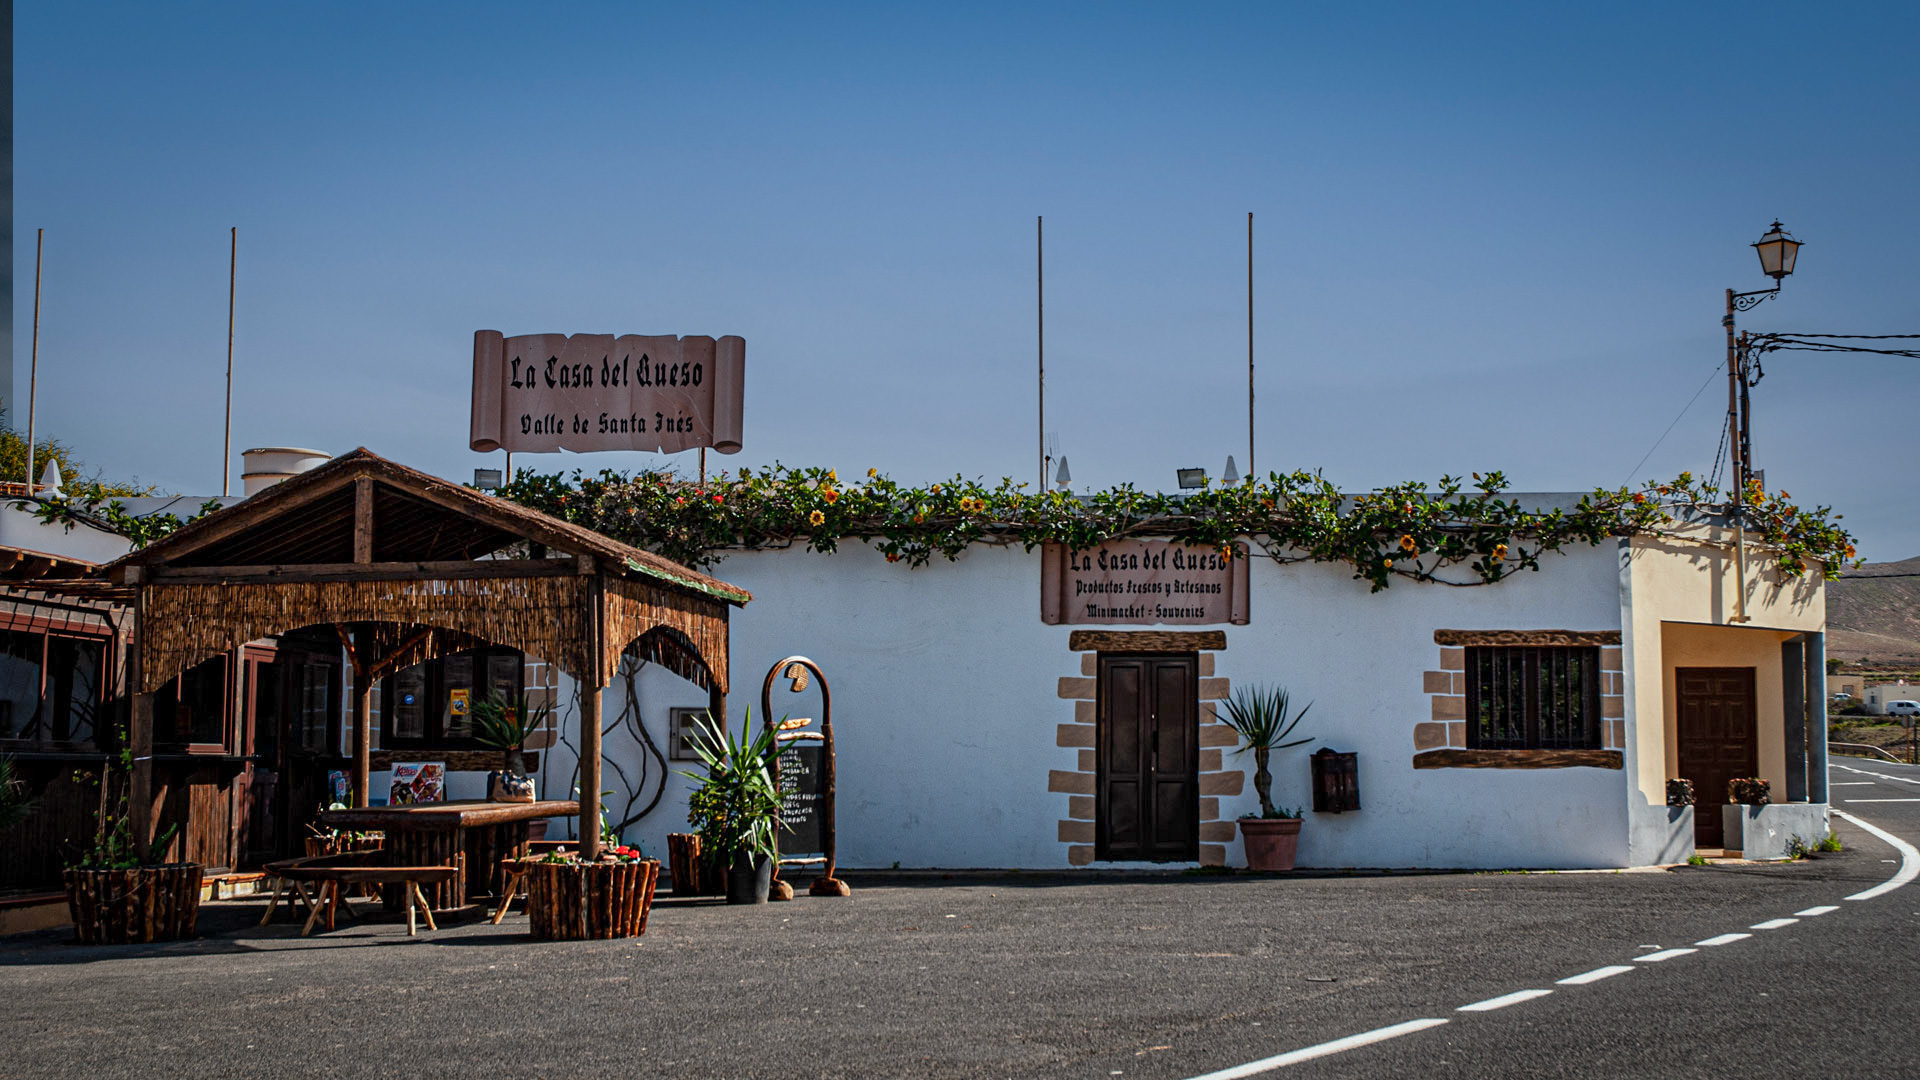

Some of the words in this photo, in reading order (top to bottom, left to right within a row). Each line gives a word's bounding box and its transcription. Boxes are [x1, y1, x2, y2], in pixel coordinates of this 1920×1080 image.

[511, 356, 536, 389] La
[544, 355, 594, 389] Casa
[601, 354, 630, 388] del
[636, 353, 703, 388] Queso
[520, 413, 564, 435] Valle
[573, 413, 589, 435] de
[598, 412, 647, 434] Santa
[655, 410, 693, 433] Inés
[1070, 551, 1091, 572] La
[1097, 549, 1138, 571] Casa
[1143, 548, 1167, 570] del
[1172, 548, 1226, 571] Queso
[1076, 579, 1124, 597] Productos
[1126, 579, 1162, 594] Frescos
[1165, 583, 1171, 597] y
[1174, 579, 1222, 594] Artesanos
[1087, 603, 1145, 618] Minimarket
[1155, 603, 1205, 618] Souvenirs
